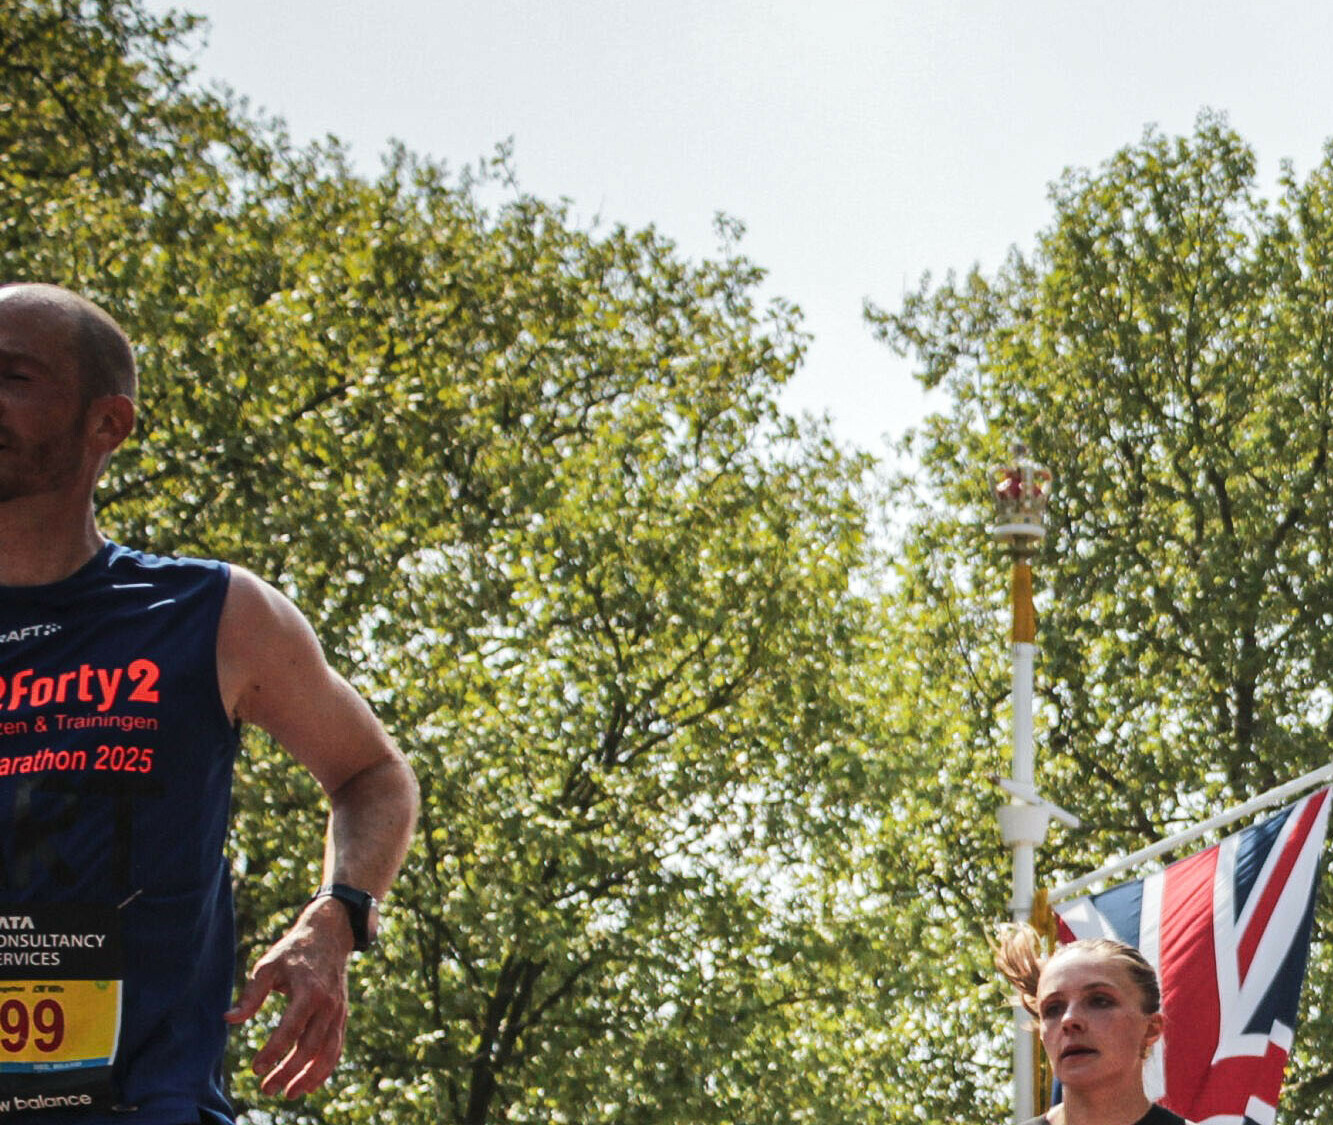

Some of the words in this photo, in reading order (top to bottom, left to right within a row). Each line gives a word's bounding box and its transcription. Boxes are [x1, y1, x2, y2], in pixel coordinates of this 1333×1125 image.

[34, 716, 48, 733] &
[55, 713, 159, 732] Trainingen
[94, 745, 154, 774] 2025
[0, 998, 65, 1053] 99
[14, 1094, 93, 1111] balance
